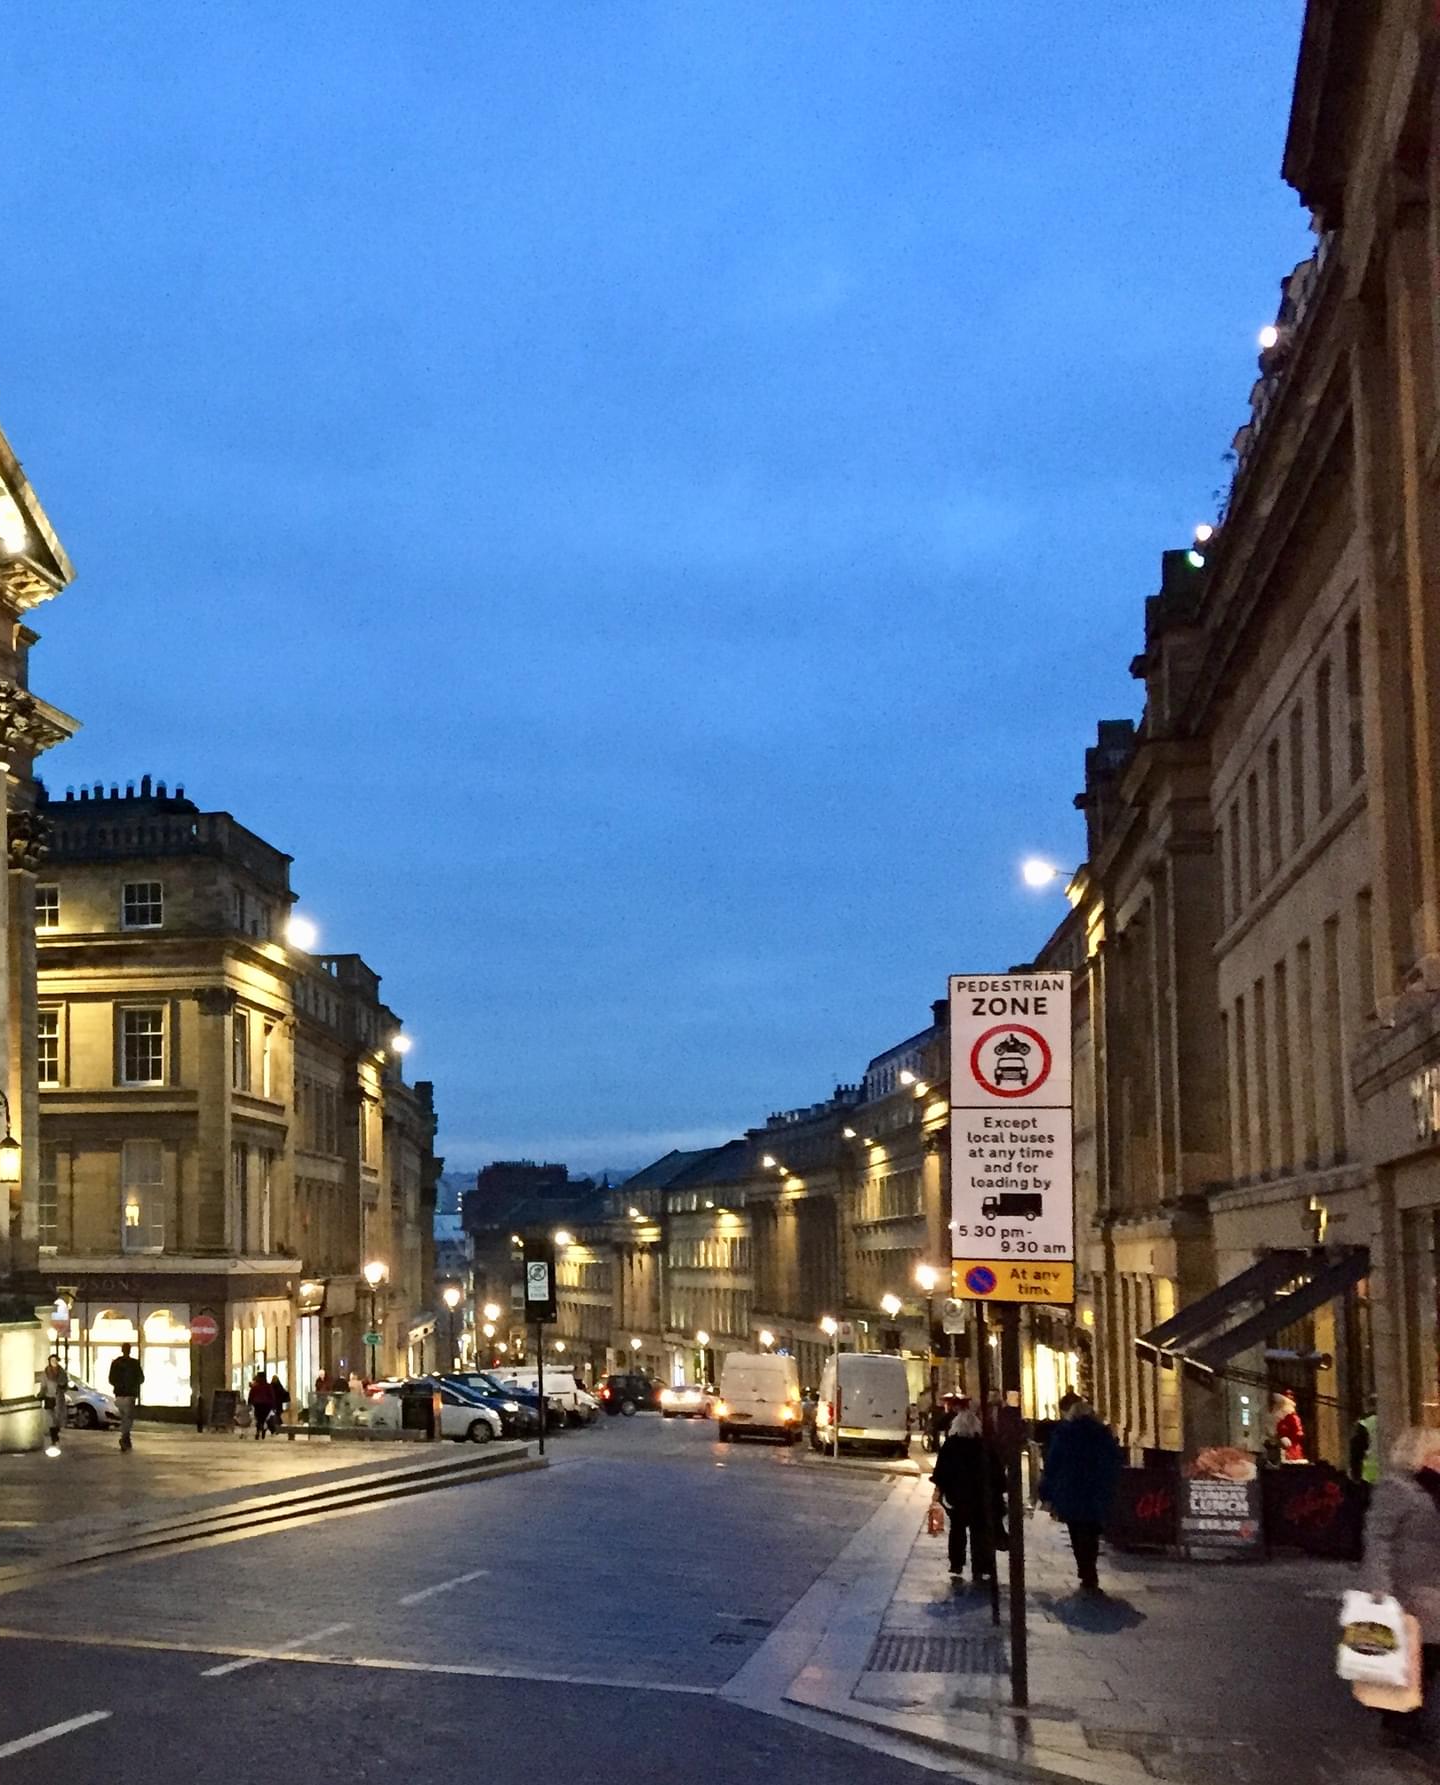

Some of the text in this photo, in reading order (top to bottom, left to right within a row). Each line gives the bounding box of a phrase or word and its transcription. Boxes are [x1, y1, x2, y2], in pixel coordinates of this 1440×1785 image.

[957, 979, 1064, 993] PEDESTRIAN
[971, 997, 1048, 1016] ZONE
[983, 1117, 1038, 1131] Except
[967, 1132, 1055, 1144] local buses
[968, 1148, 1054, 1161] at any time
[984, 1162, 1039, 1173] and for
[971, 1177, 1052, 1191] loading by
[959, 1225, 996, 1238] 5.30
[1001, 1241, 1066, 1254] 9.30 am
[1010, 1268, 1028, 1280] At
[1190, 1491, 1248, 1500] SUNDAY
